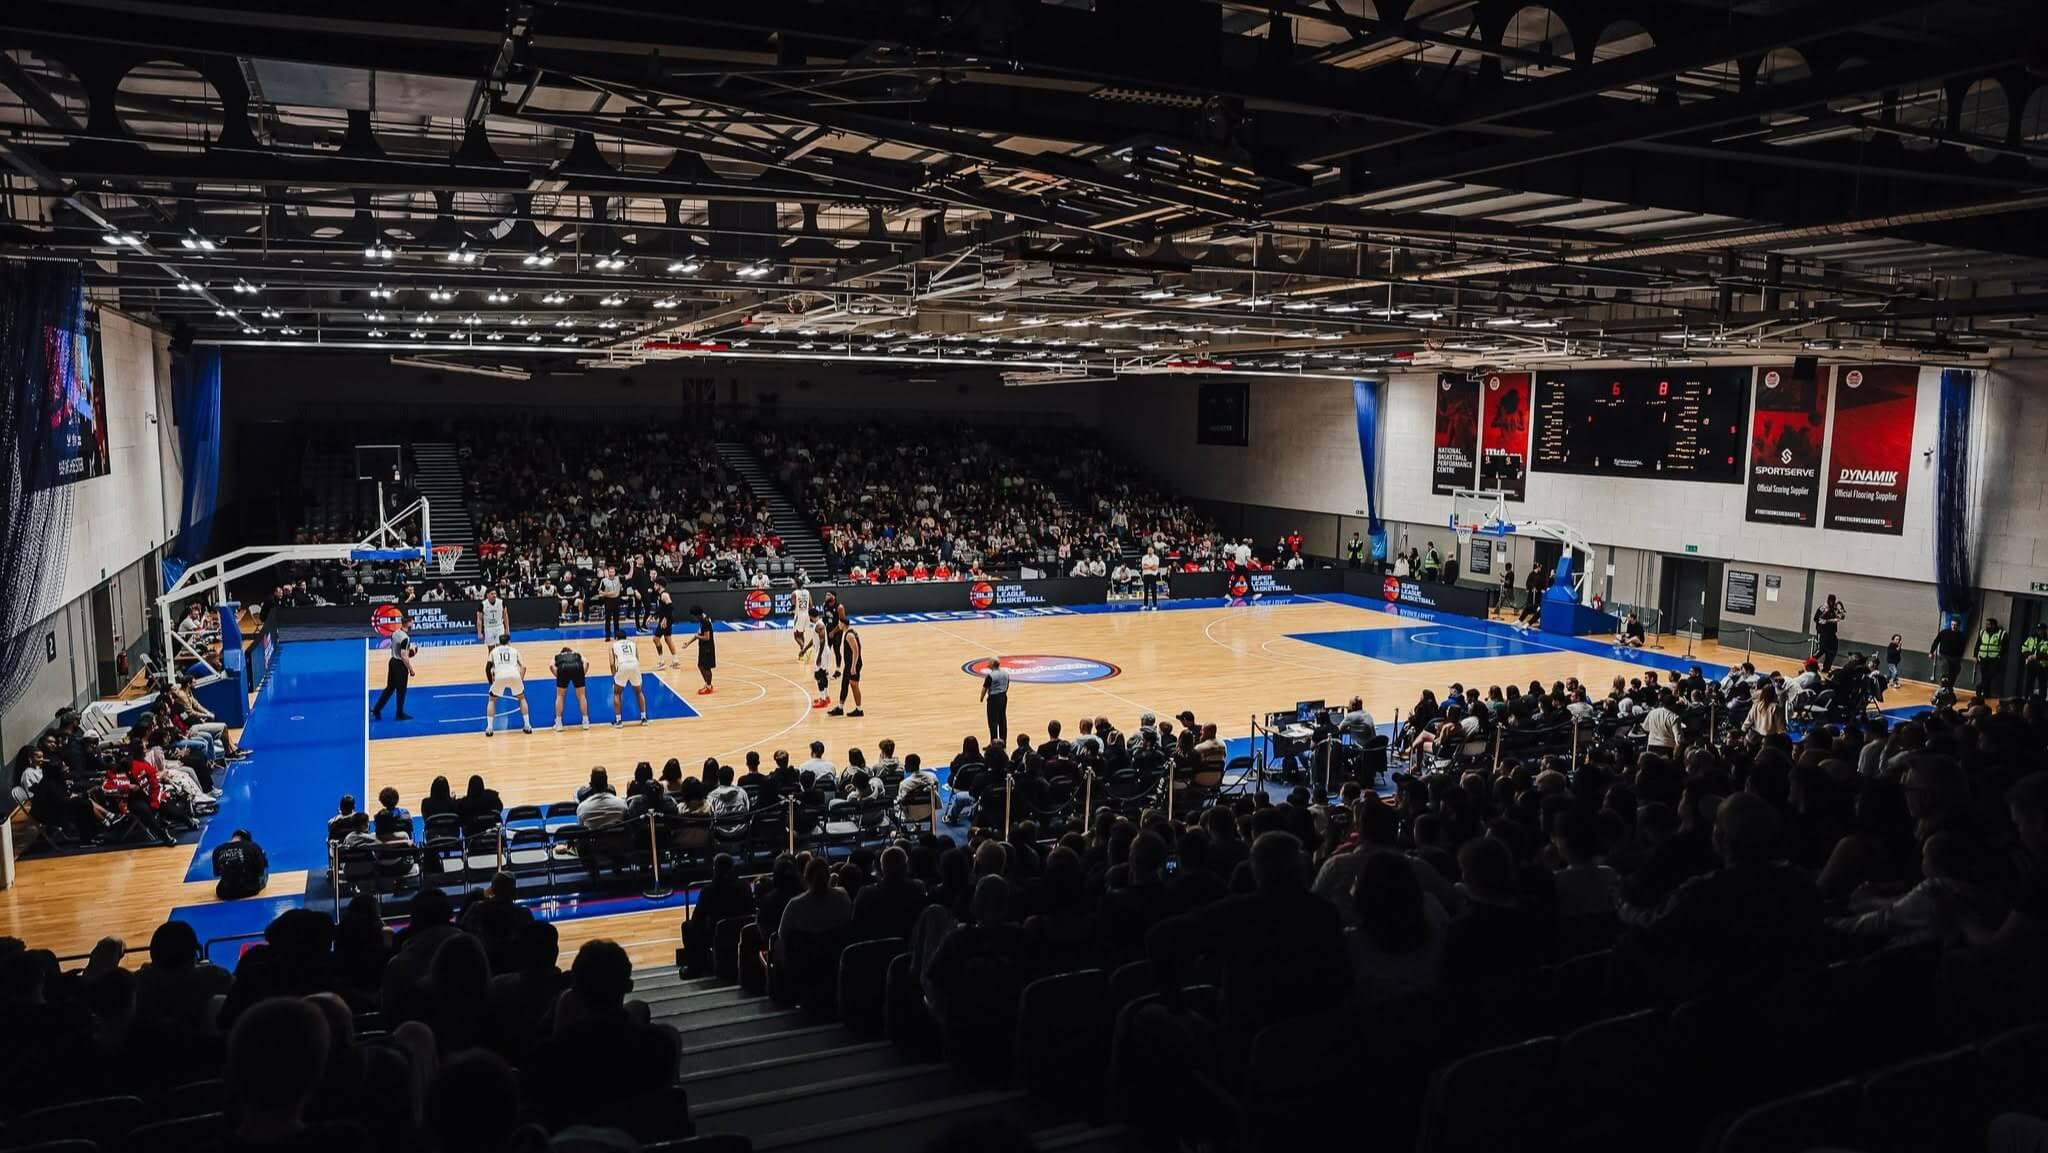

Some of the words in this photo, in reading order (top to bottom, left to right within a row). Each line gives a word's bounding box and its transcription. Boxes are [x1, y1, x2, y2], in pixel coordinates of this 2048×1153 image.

[1659, 381, 1669, 396] 8
[1437, 454, 1467, 462] BASKETBALL
[1436, 460, 1473, 468] PERFORMANCE
[1436, 466, 1455, 474] CENTRE
[1755, 466, 1815, 478] SPORTSERVE
[1839, 469, 1899, 483] DYNAMIK
[1756, 483, 1773, 493] Official
[1773, 485, 1790, 495] Scoring
[1790, 485, 1809, 497] Supplier
[1834, 488, 1853, 498] Official
[1853, 489, 1875, 501] Flooring
[1875, 491, 1898, 503] Supplier
[996, 584, 1022, 592] SUPER
[996, 590, 1026, 598] LEAGUE
[996, 596, 1045, 604] BASKETBALL
[1400, 593, 1436, 606] BASKETBALL
[407, 607, 442, 616] SUPER
[414, 614, 448, 623] EAGUE
[725, 606, 1077, 631] MCHESTER
[48, 637, 54, 655] 2
[621, 644, 633, 653] 21
[500, 652, 510, 662] 10
